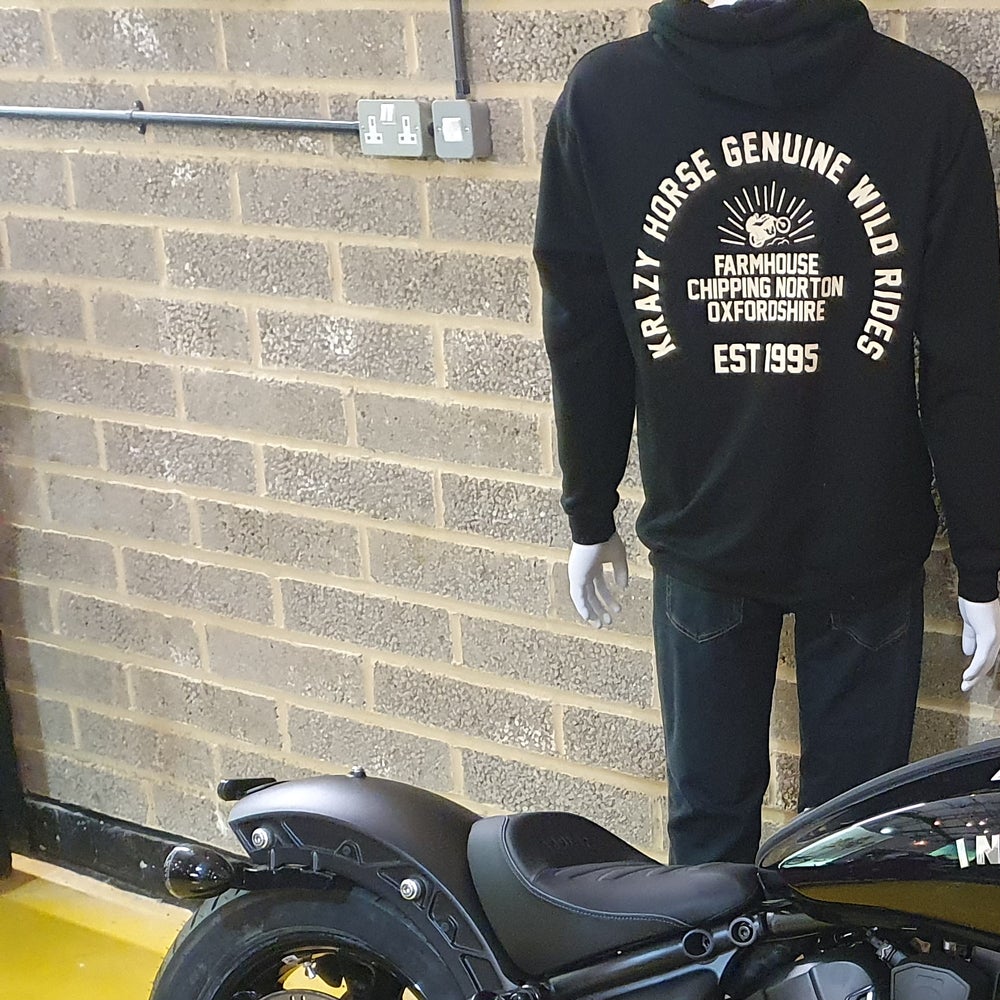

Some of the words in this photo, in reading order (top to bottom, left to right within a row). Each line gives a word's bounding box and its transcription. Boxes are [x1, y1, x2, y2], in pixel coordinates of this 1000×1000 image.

[721, 131, 852, 185] GENUINE
[642, 148, 718, 243] HORSE
[847, 174, 900, 257] WILD
[686, 276, 772, 301] CHIPPING
[774, 275, 844, 299] NORTON
[714, 252, 820, 276] FARMHOUSE
[632, 248, 677, 360] KRAZY
[707, 299, 826, 323] OXFORDSHIRE
[857, 268, 903, 361] RIDES
[713, 342, 762, 374] EST
[763, 342, 820, 374] 1995
